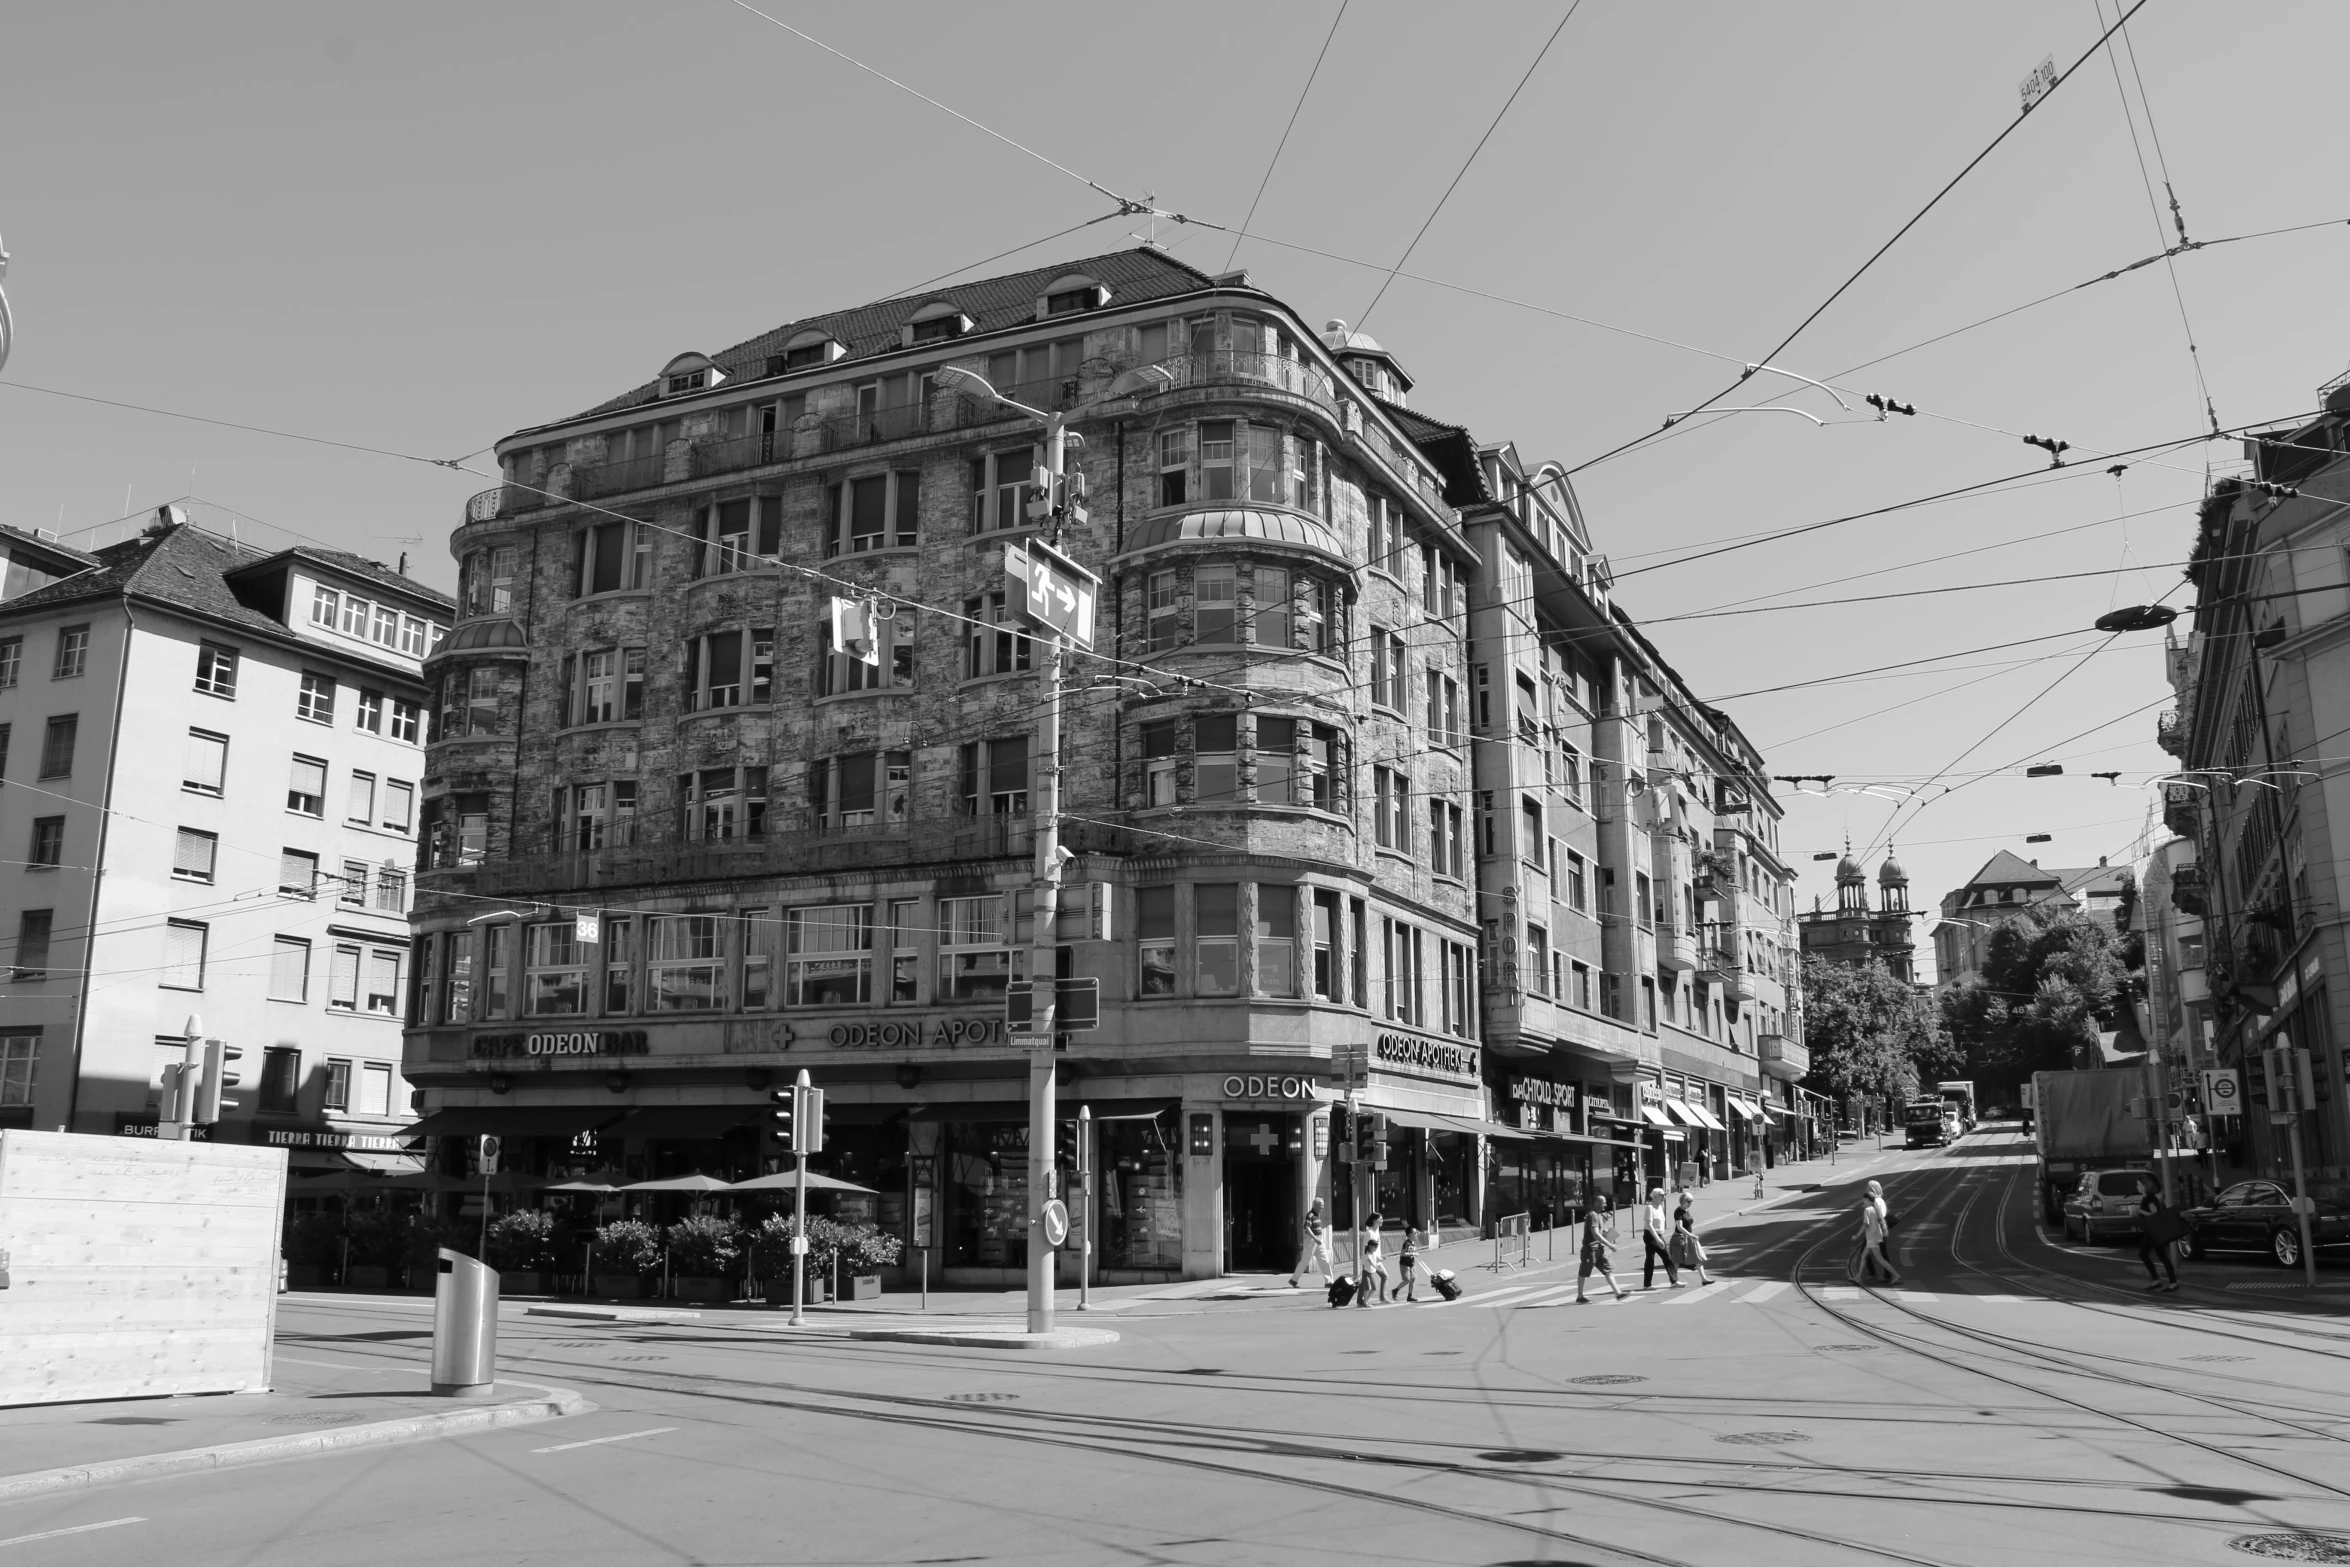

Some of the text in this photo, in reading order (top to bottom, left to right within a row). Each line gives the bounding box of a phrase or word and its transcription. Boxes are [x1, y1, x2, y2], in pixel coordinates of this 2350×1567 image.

[1502, 886, 1518, 1006] SPORT
[528, 1033, 599, 1055] ODEON
[603, 1031, 649, 1054] BAR
[828, 1021, 922, 1047] ODEON
[1010, 1036, 1050, 1048] Limmatquai
[1382, 1033, 1465, 1069] ODEON APOTHEKE
[1223, 1075, 1316, 1099] ODEON
[1553, 1083, 1575, 1108] SPORT
[269, 1130, 400, 1149] TIERRA TIERRA TIERRA
